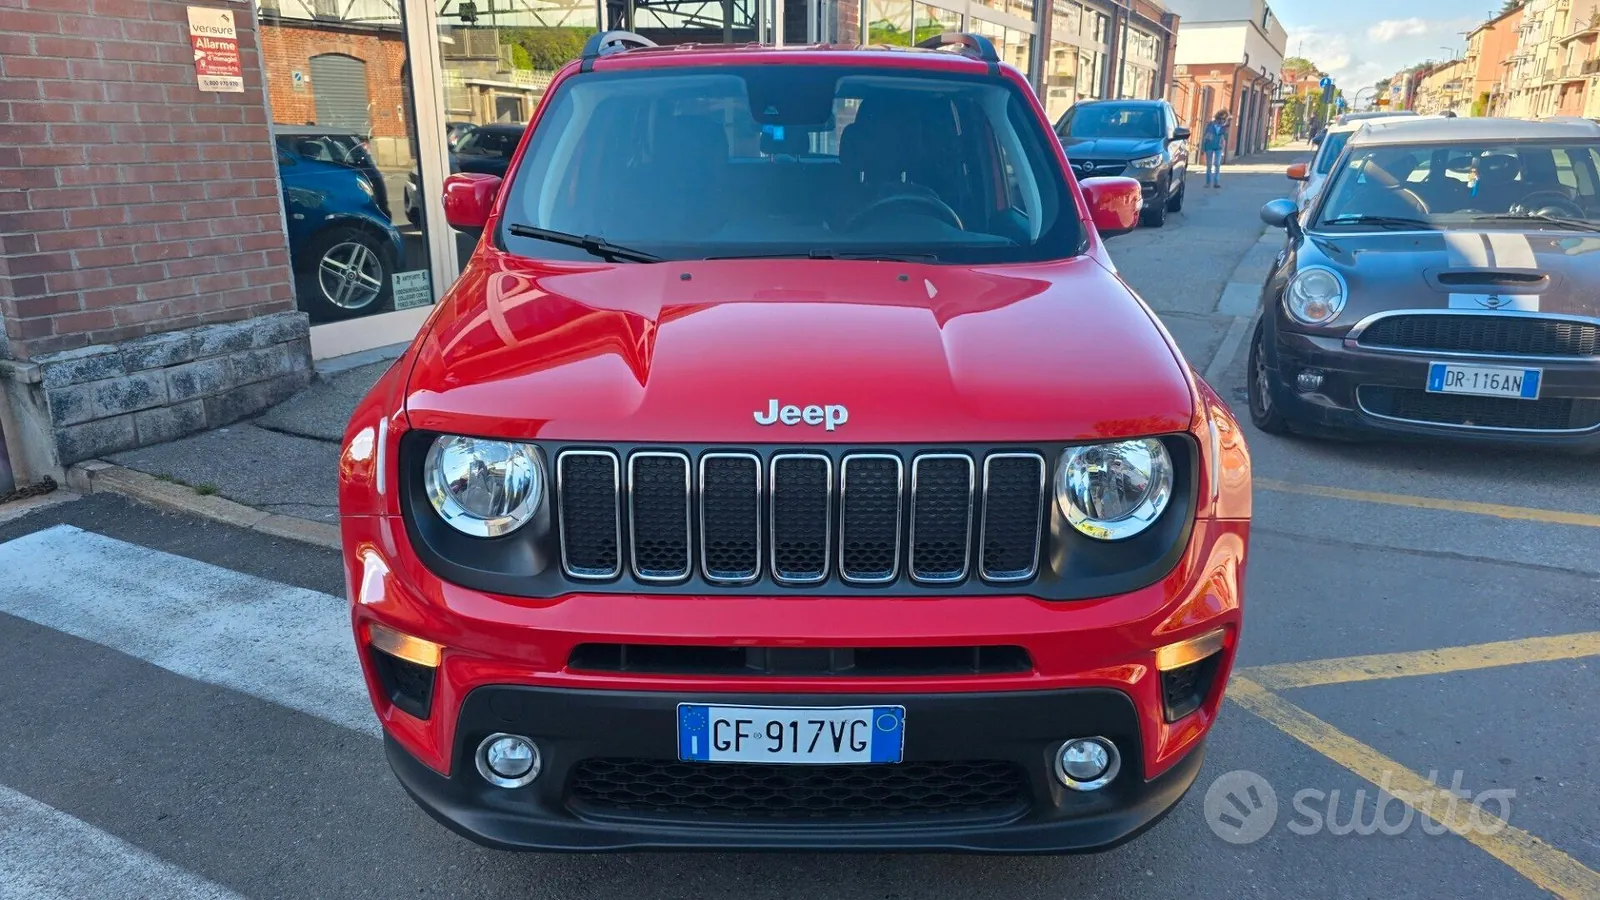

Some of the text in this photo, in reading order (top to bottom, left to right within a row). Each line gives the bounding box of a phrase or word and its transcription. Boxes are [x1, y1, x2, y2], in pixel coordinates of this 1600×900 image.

[192, 24, 233, 35] verisure
[196, 37, 236, 50] Allarme
[1445, 370, 1523, 392] DR 116AN
[753, 399, 849, 432] Jeep
[713, 719, 868, 753] GF 917VG
